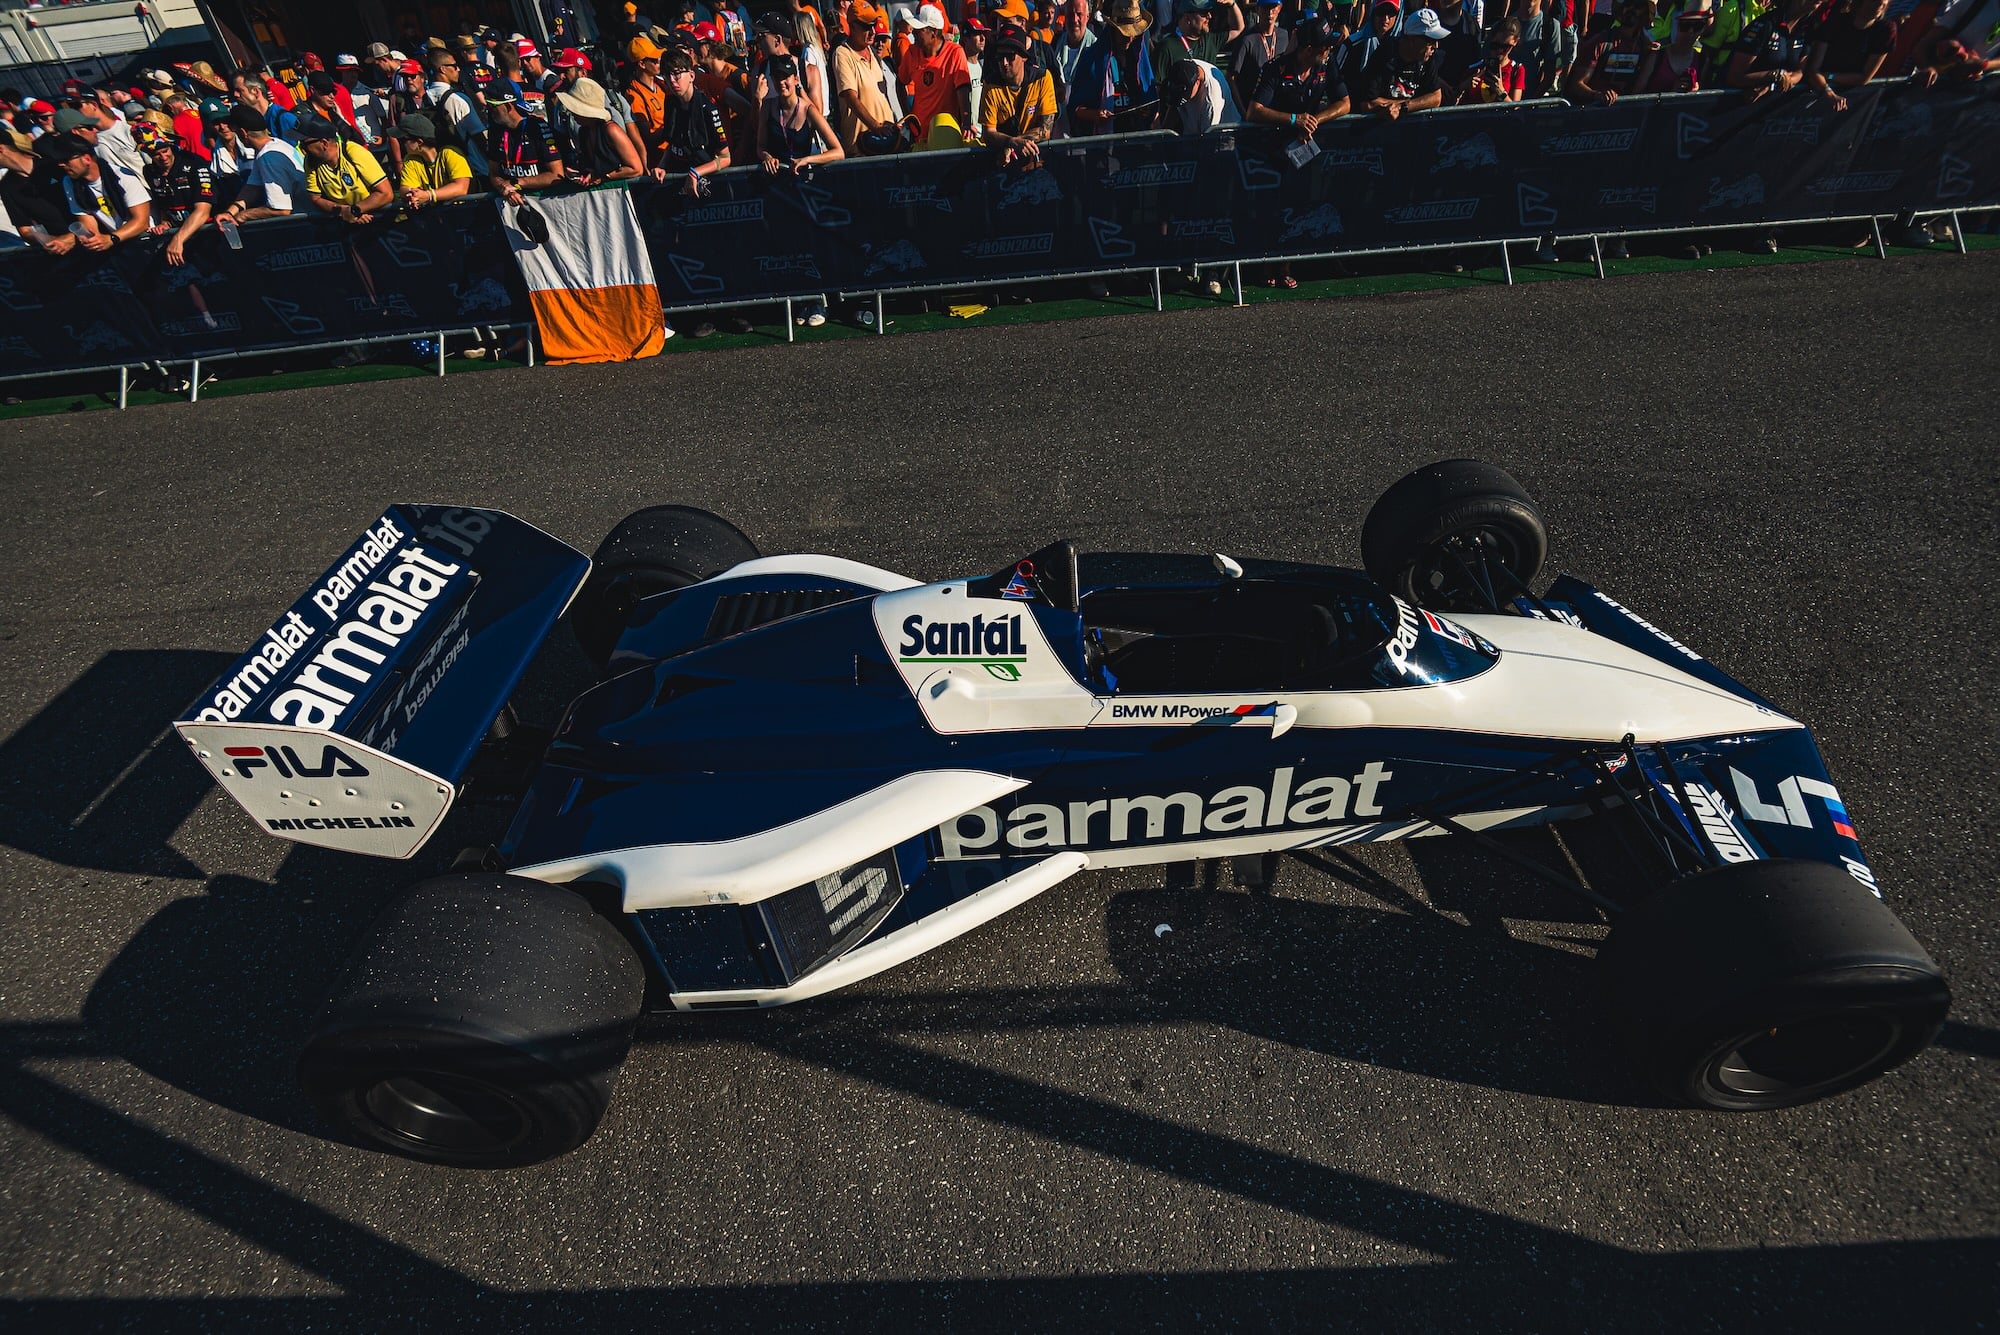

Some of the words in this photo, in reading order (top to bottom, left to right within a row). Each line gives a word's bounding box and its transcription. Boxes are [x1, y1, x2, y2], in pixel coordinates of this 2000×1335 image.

[686, 202, 761, 223] #BORN2RACE
[312, 515, 405, 622] parmalat
[270, 544, 461, 731] armalat
[1593, 591, 1703, 661] MICHELIN
[1112, 705, 1158, 718] BMW
[224, 744, 370, 780] FILA
[265, 815, 415, 831] MICHELIN
[938, 762, 1393, 858] parmalat
